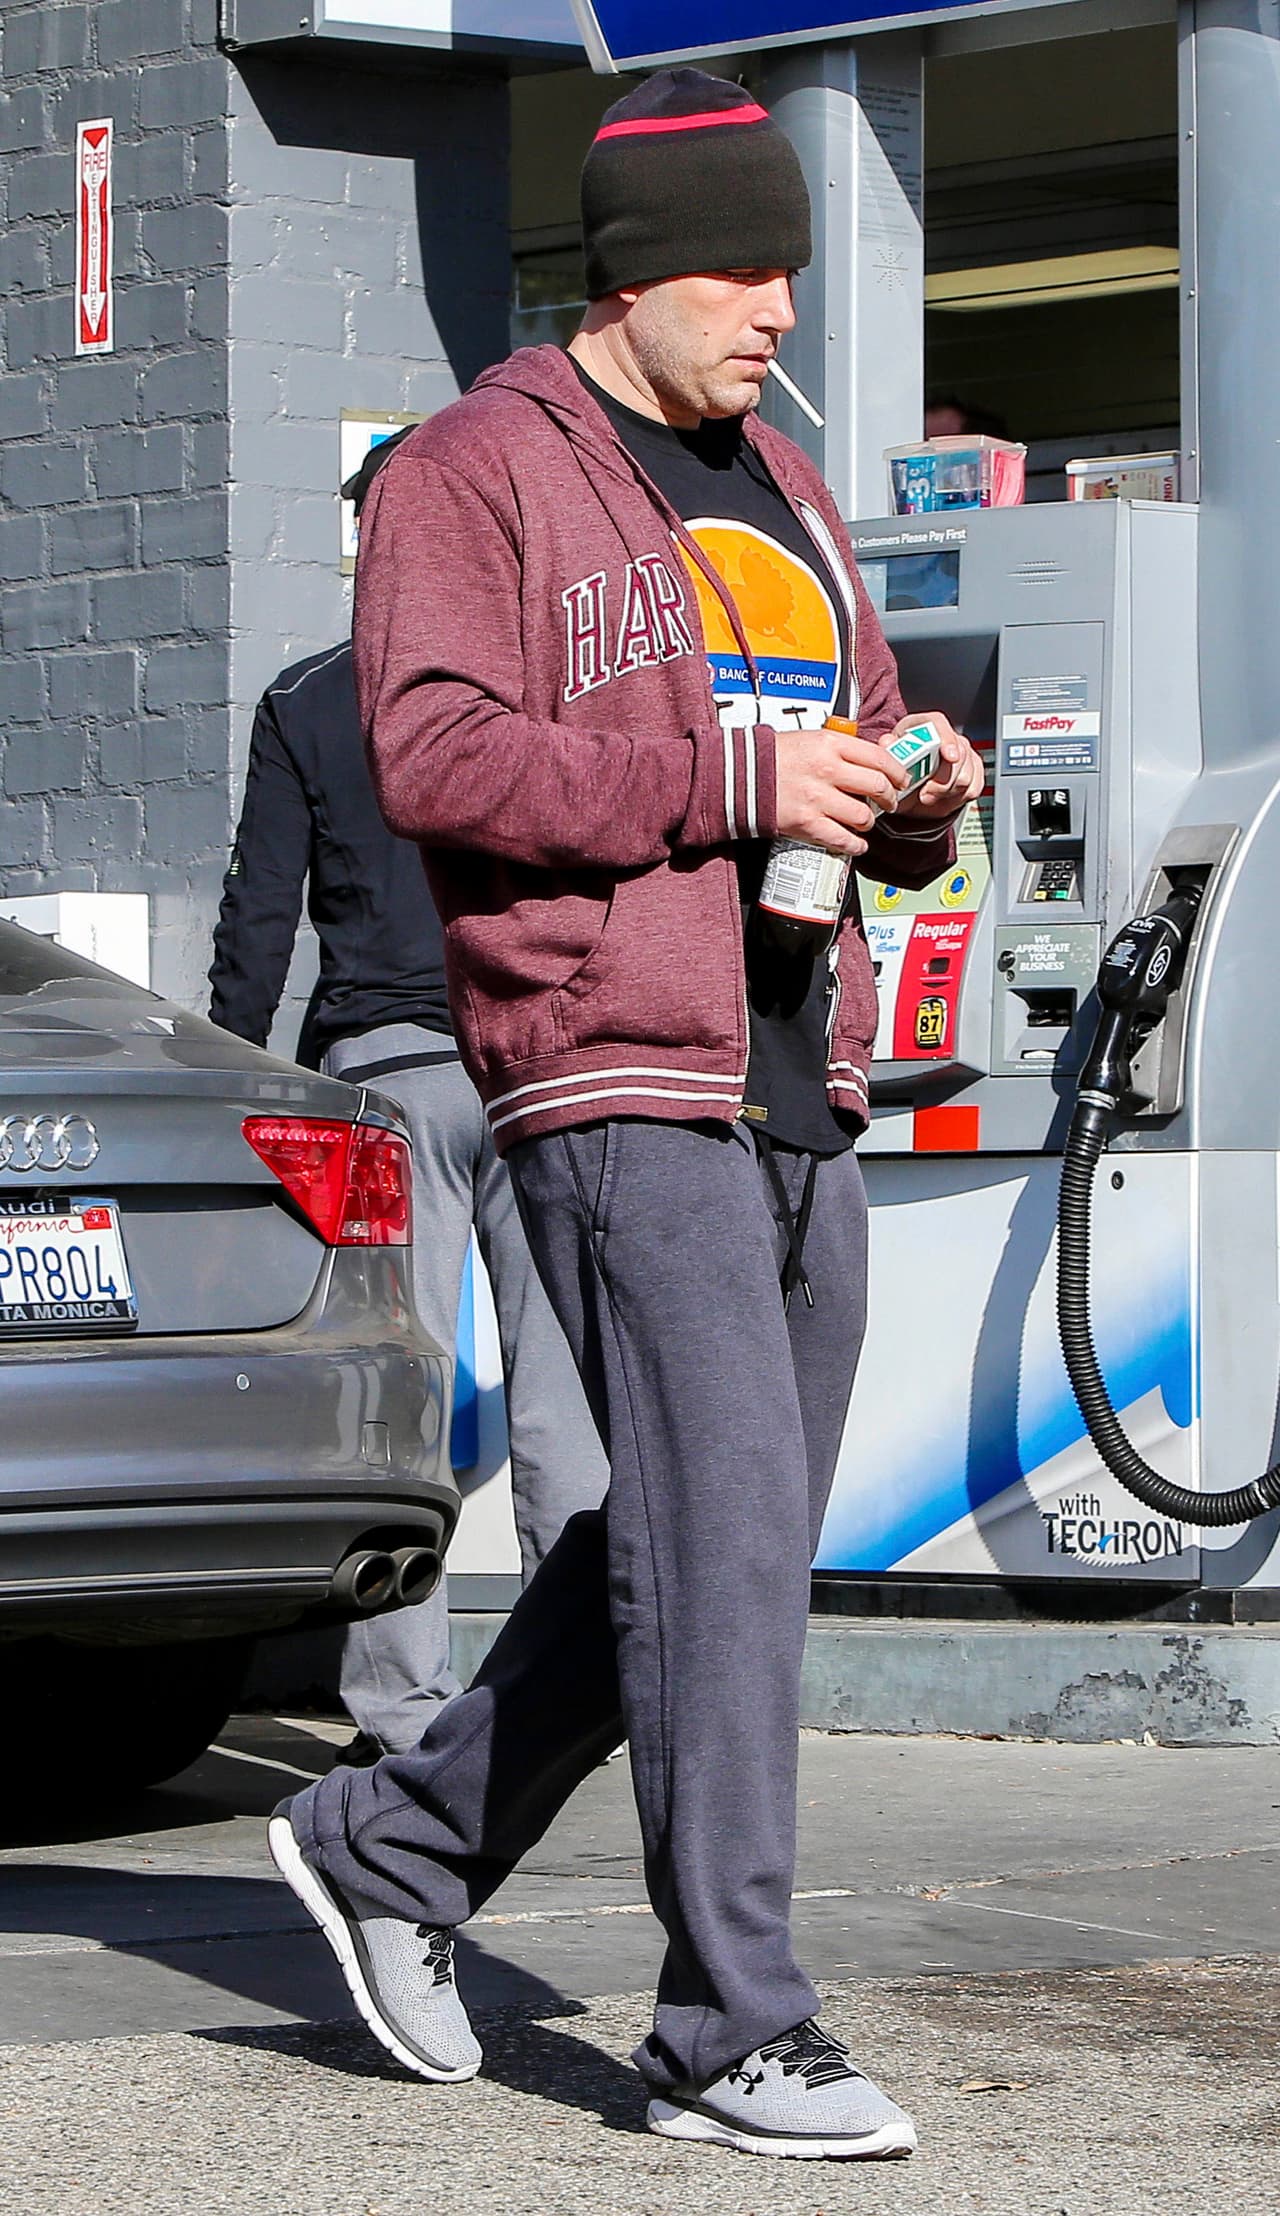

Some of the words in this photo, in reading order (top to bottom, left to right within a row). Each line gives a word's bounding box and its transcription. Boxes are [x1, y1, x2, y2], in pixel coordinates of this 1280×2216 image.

[83, 152, 107, 171] FIRE
[90, 173, 98, 323] EXTINGUISHER
[859, 536, 900, 548] Customers
[901, 531, 928, 544] Please
[929, 529, 944, 543] Pay
[945, 528, 966, 540] First
[562, 552, 694, 702] HAR
[719, 667, 749, 681] BANC
[767, 671, 827, 688] CALIFORNIA
[1024, 716, 1076, 733] FastPay
[867, 926, 895, 939] Plus
[913, 921, 968, 940] Regular
[1034, 934, 1051, 943] WE
[1016, 943, 1070, 953] APPRECIATE
[1029, 952, 1057, 962] YOUR
[1020, 961, 1065, 972] BUSINESS
[919, 1014, 940, 1033] 87
[32, 1302, 120, 1319] MONICA
[1059, 1493, 1100, 1516] with
[1042, 1513, 1182, 1564] TECHRON
